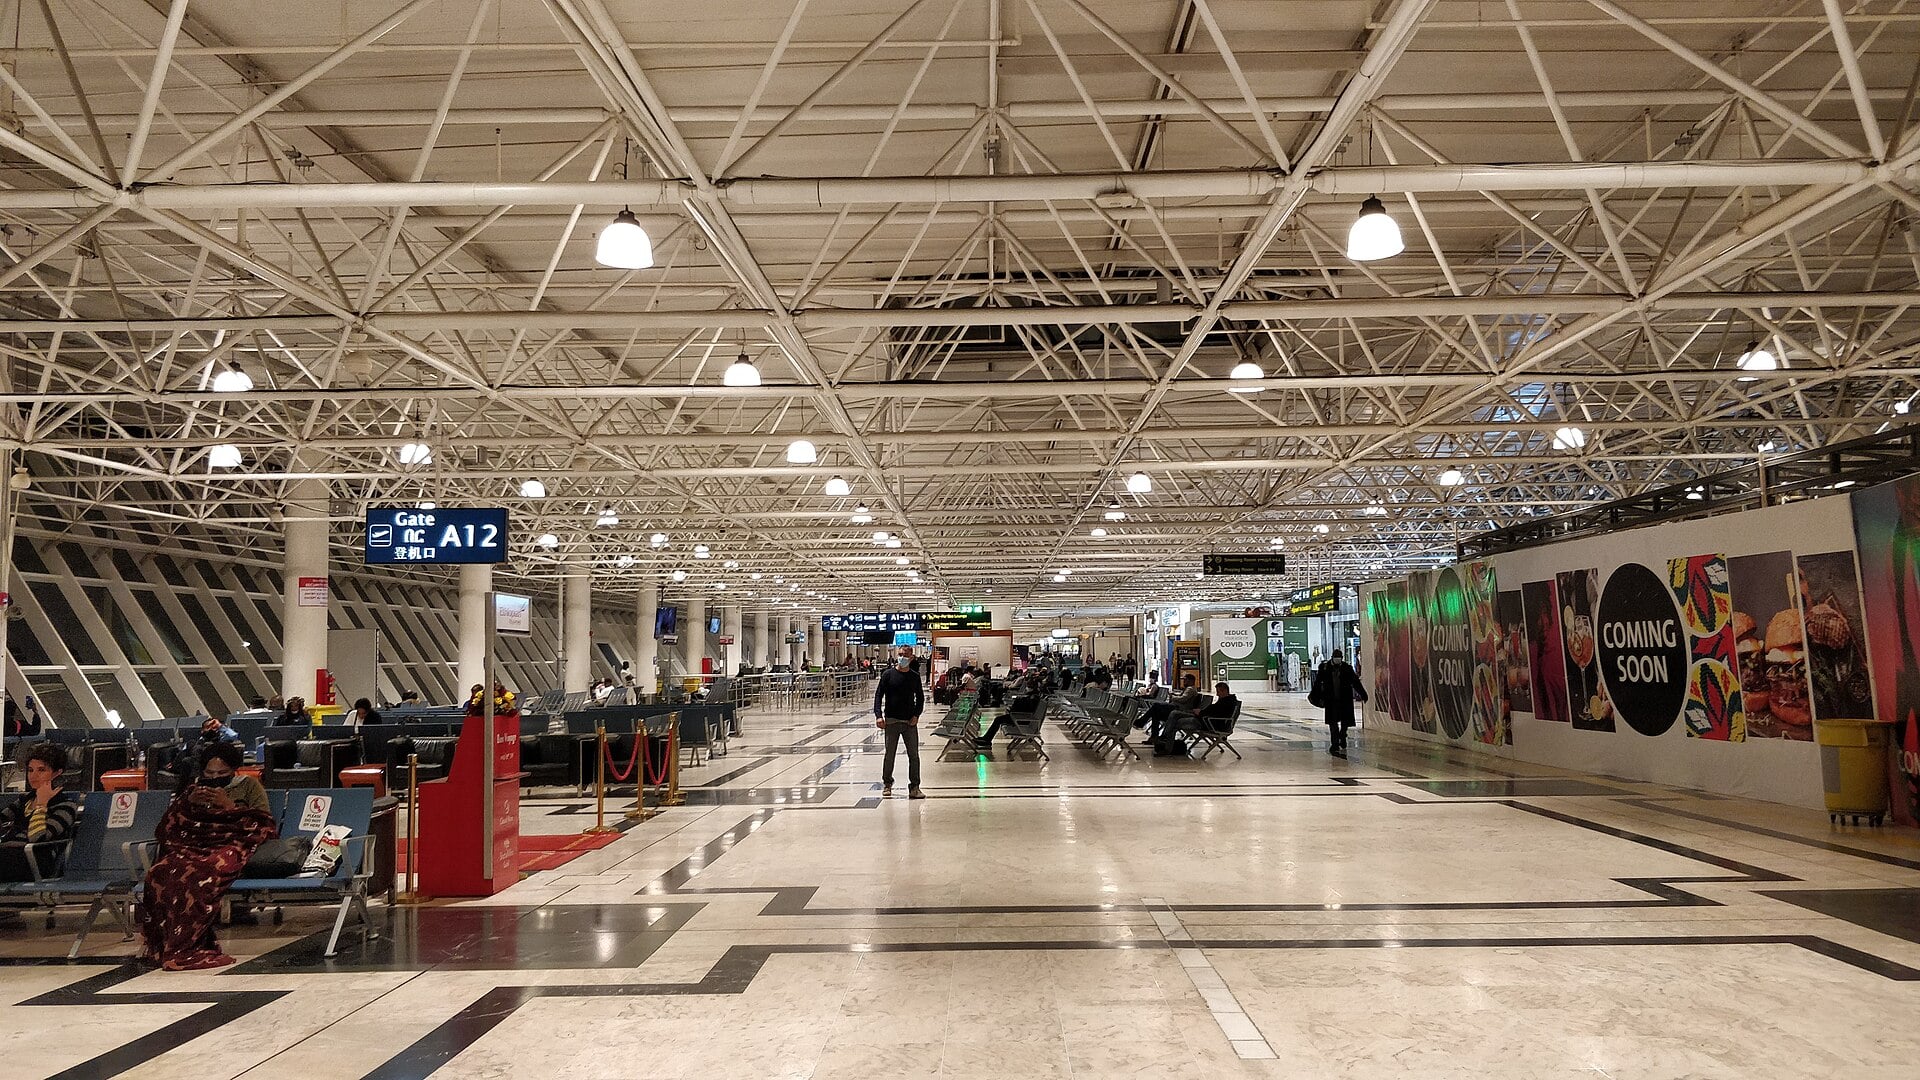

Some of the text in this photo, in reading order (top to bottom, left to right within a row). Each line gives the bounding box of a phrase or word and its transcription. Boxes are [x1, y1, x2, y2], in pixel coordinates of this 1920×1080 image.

[395, 511, 436, 526] Gate
[404, 528, 425, 543] በር
[440, 524, 498, 548] A12
[394, 546, 436, 560] 登机口
[1432, 624, 1469, 651] COMING
[1603, 619, 1677, 648] COMING
[1438, 658, 1465, 687] SOON
[1617, 655, 1668, 683] SOON
